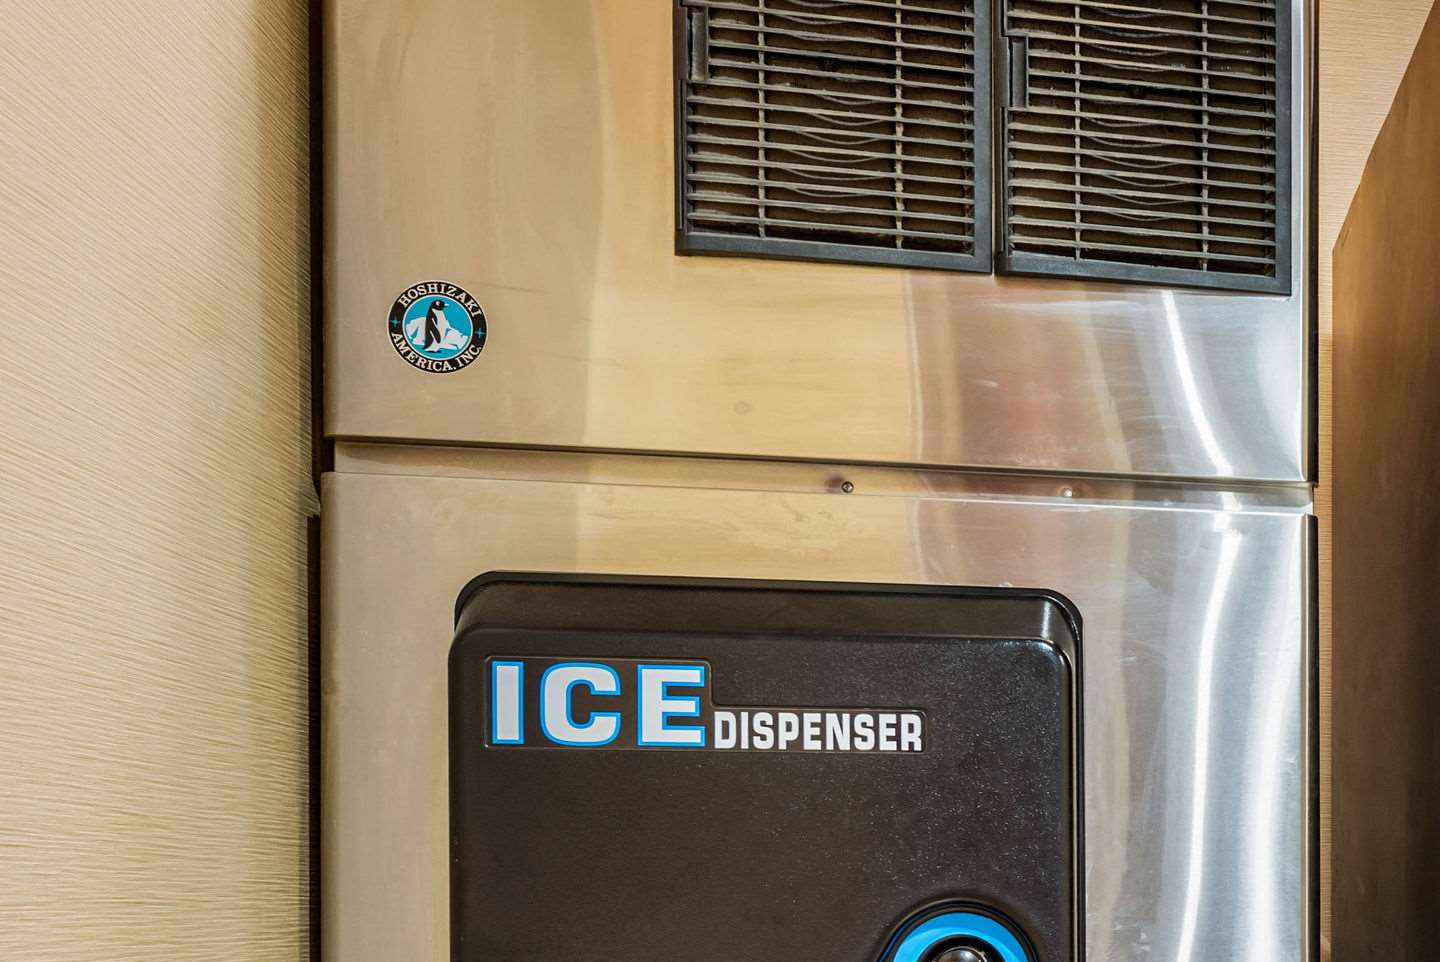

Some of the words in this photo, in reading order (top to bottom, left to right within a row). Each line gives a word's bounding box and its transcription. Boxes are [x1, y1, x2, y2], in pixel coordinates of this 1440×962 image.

[398, 283, 482, 317] HOSHIZAKI
[492, 661, 705, 746] ICE
[714, 711, 922, 751] DISPENSER
